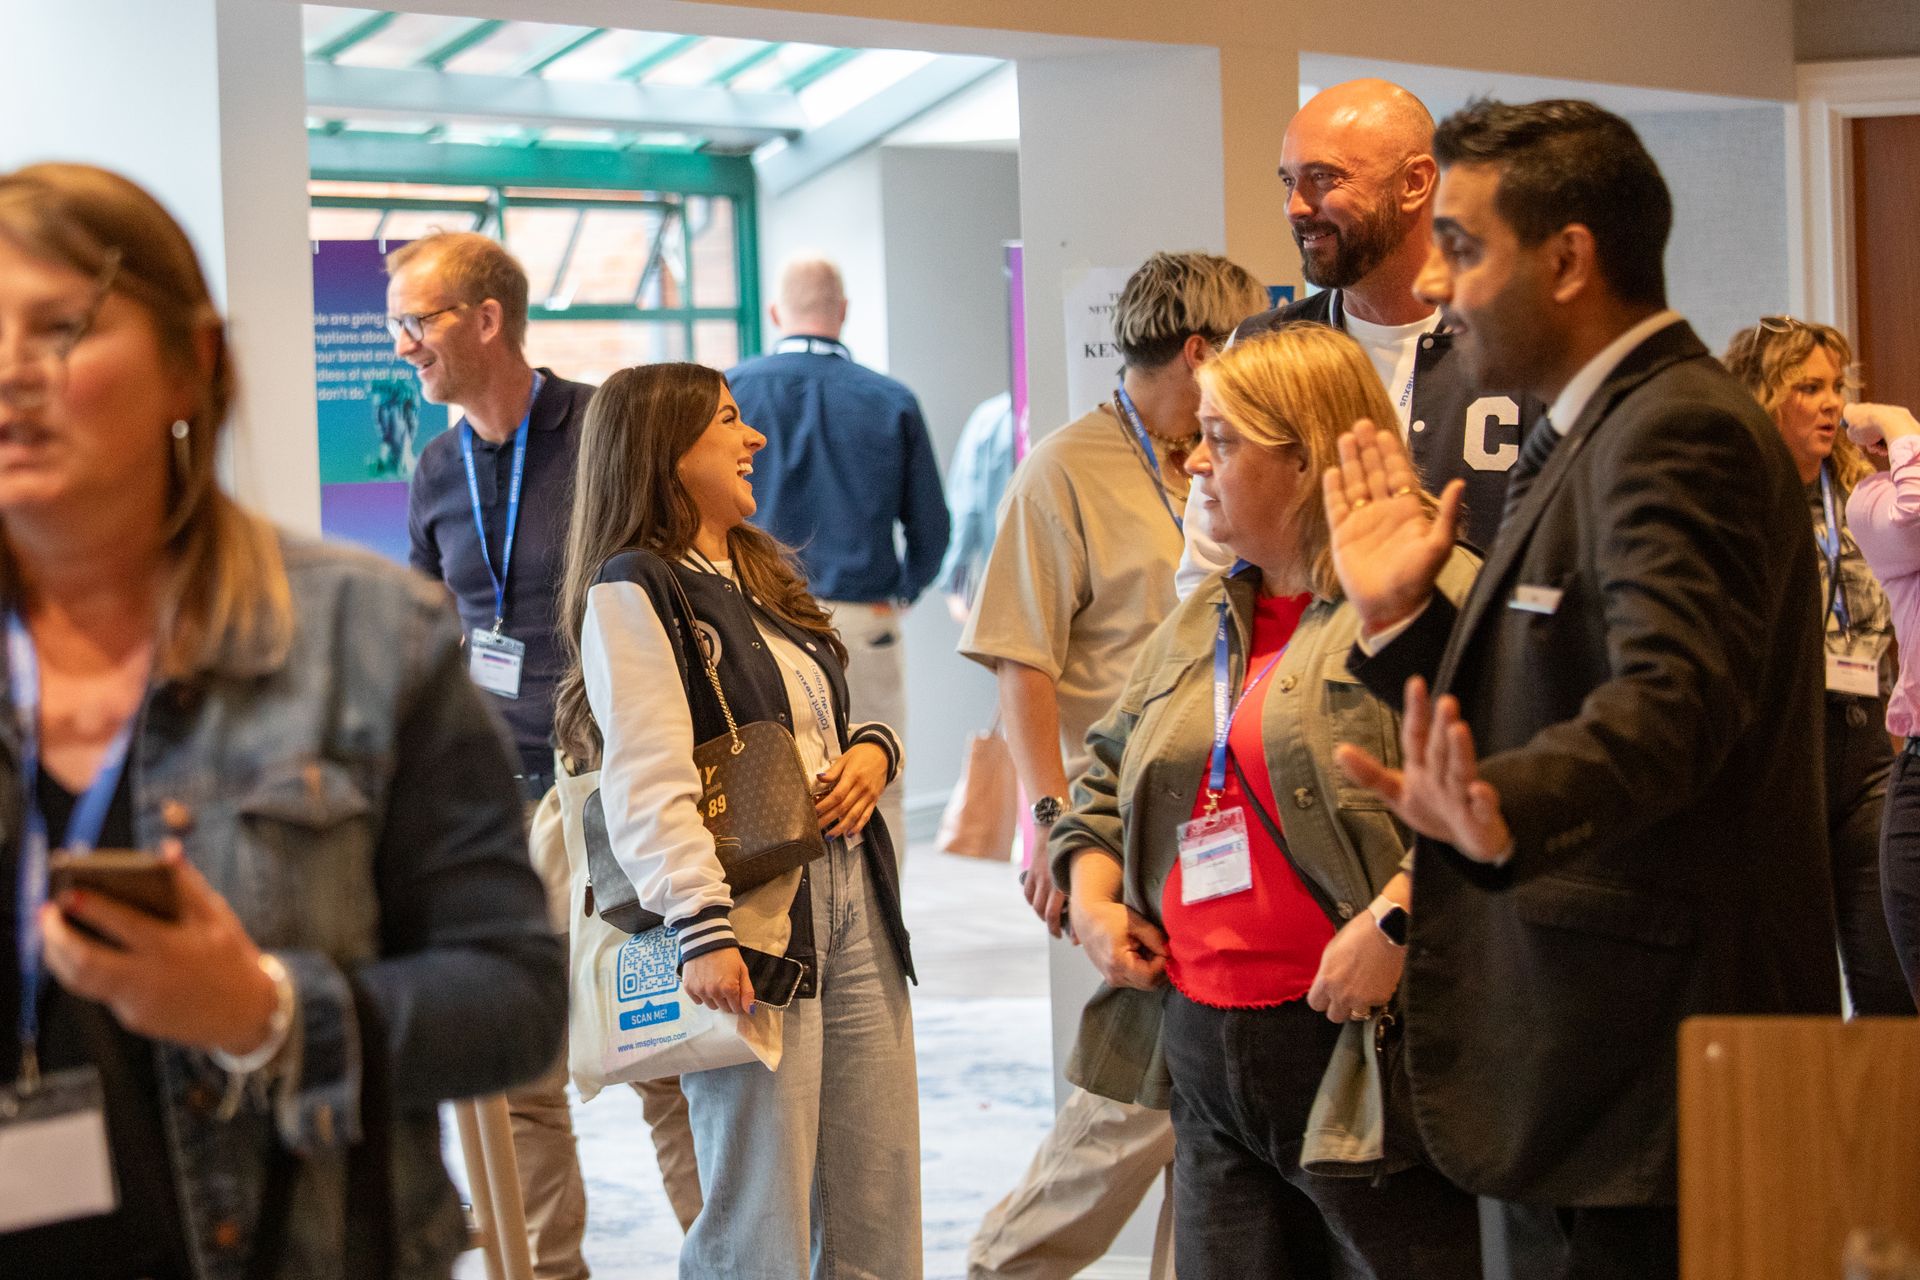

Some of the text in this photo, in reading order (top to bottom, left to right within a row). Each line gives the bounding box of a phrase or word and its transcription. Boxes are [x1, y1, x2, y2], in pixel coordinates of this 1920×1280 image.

[330, 313, 350, 325] are
[351, 313, 384, 329] going
[361, 331, 394, 344] abou
[338, 350, 373, 363] brand
[348, 367, 360, 381] of
[362, 367, 390, 381] what
[391, 369, 413, 384] you
[318, 387, 347, 400] don't
[1463, 396, 1519, 471] C
[811, 664, 825, 694] talent
[795, 669, 830, 731] talent nexus
[1215, 682, 1227, 714] talent
[708, 794, 727, 818] 89
[631, 1009, 668, 1025] SCAN ME!
